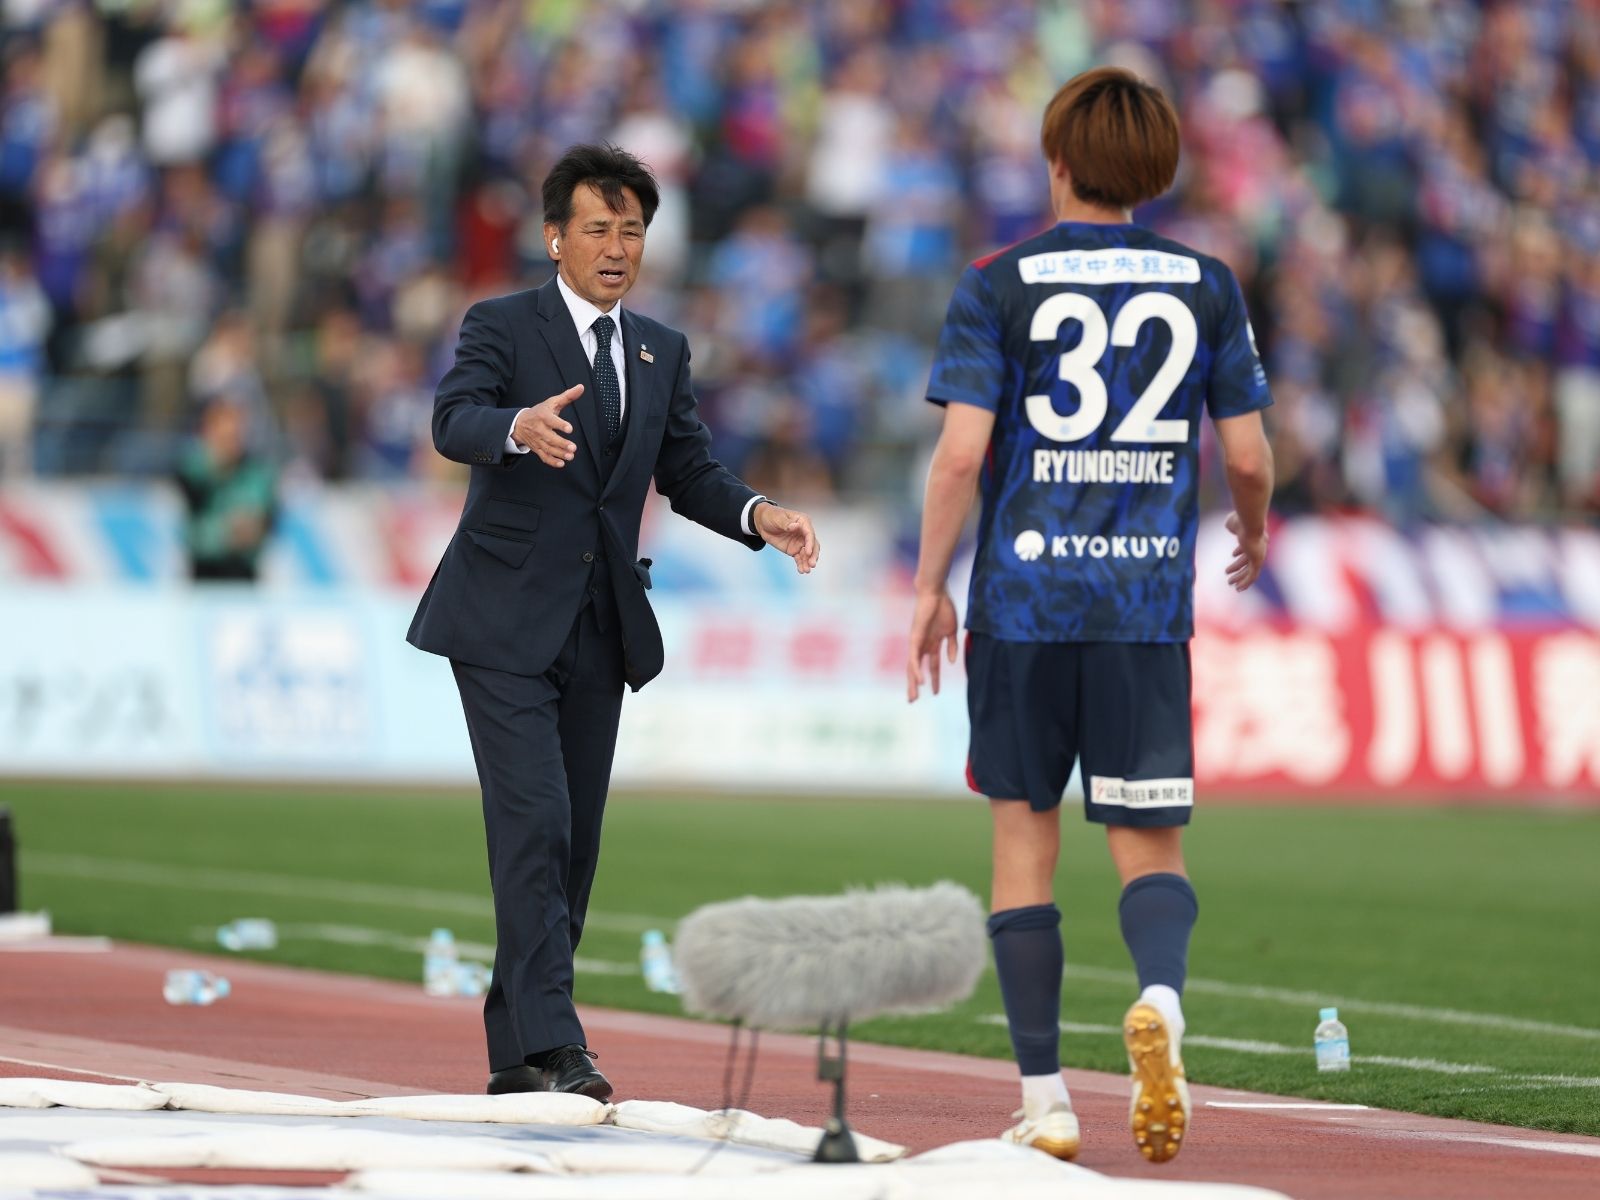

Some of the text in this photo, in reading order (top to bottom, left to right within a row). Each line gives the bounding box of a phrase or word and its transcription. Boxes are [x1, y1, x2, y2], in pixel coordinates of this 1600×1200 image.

[1025, 291, 1198, 443] 32
[1033, 449, 1175, 484] RYUNOSUKE
[1051, 534, 1180, 560] KYOKUYO
